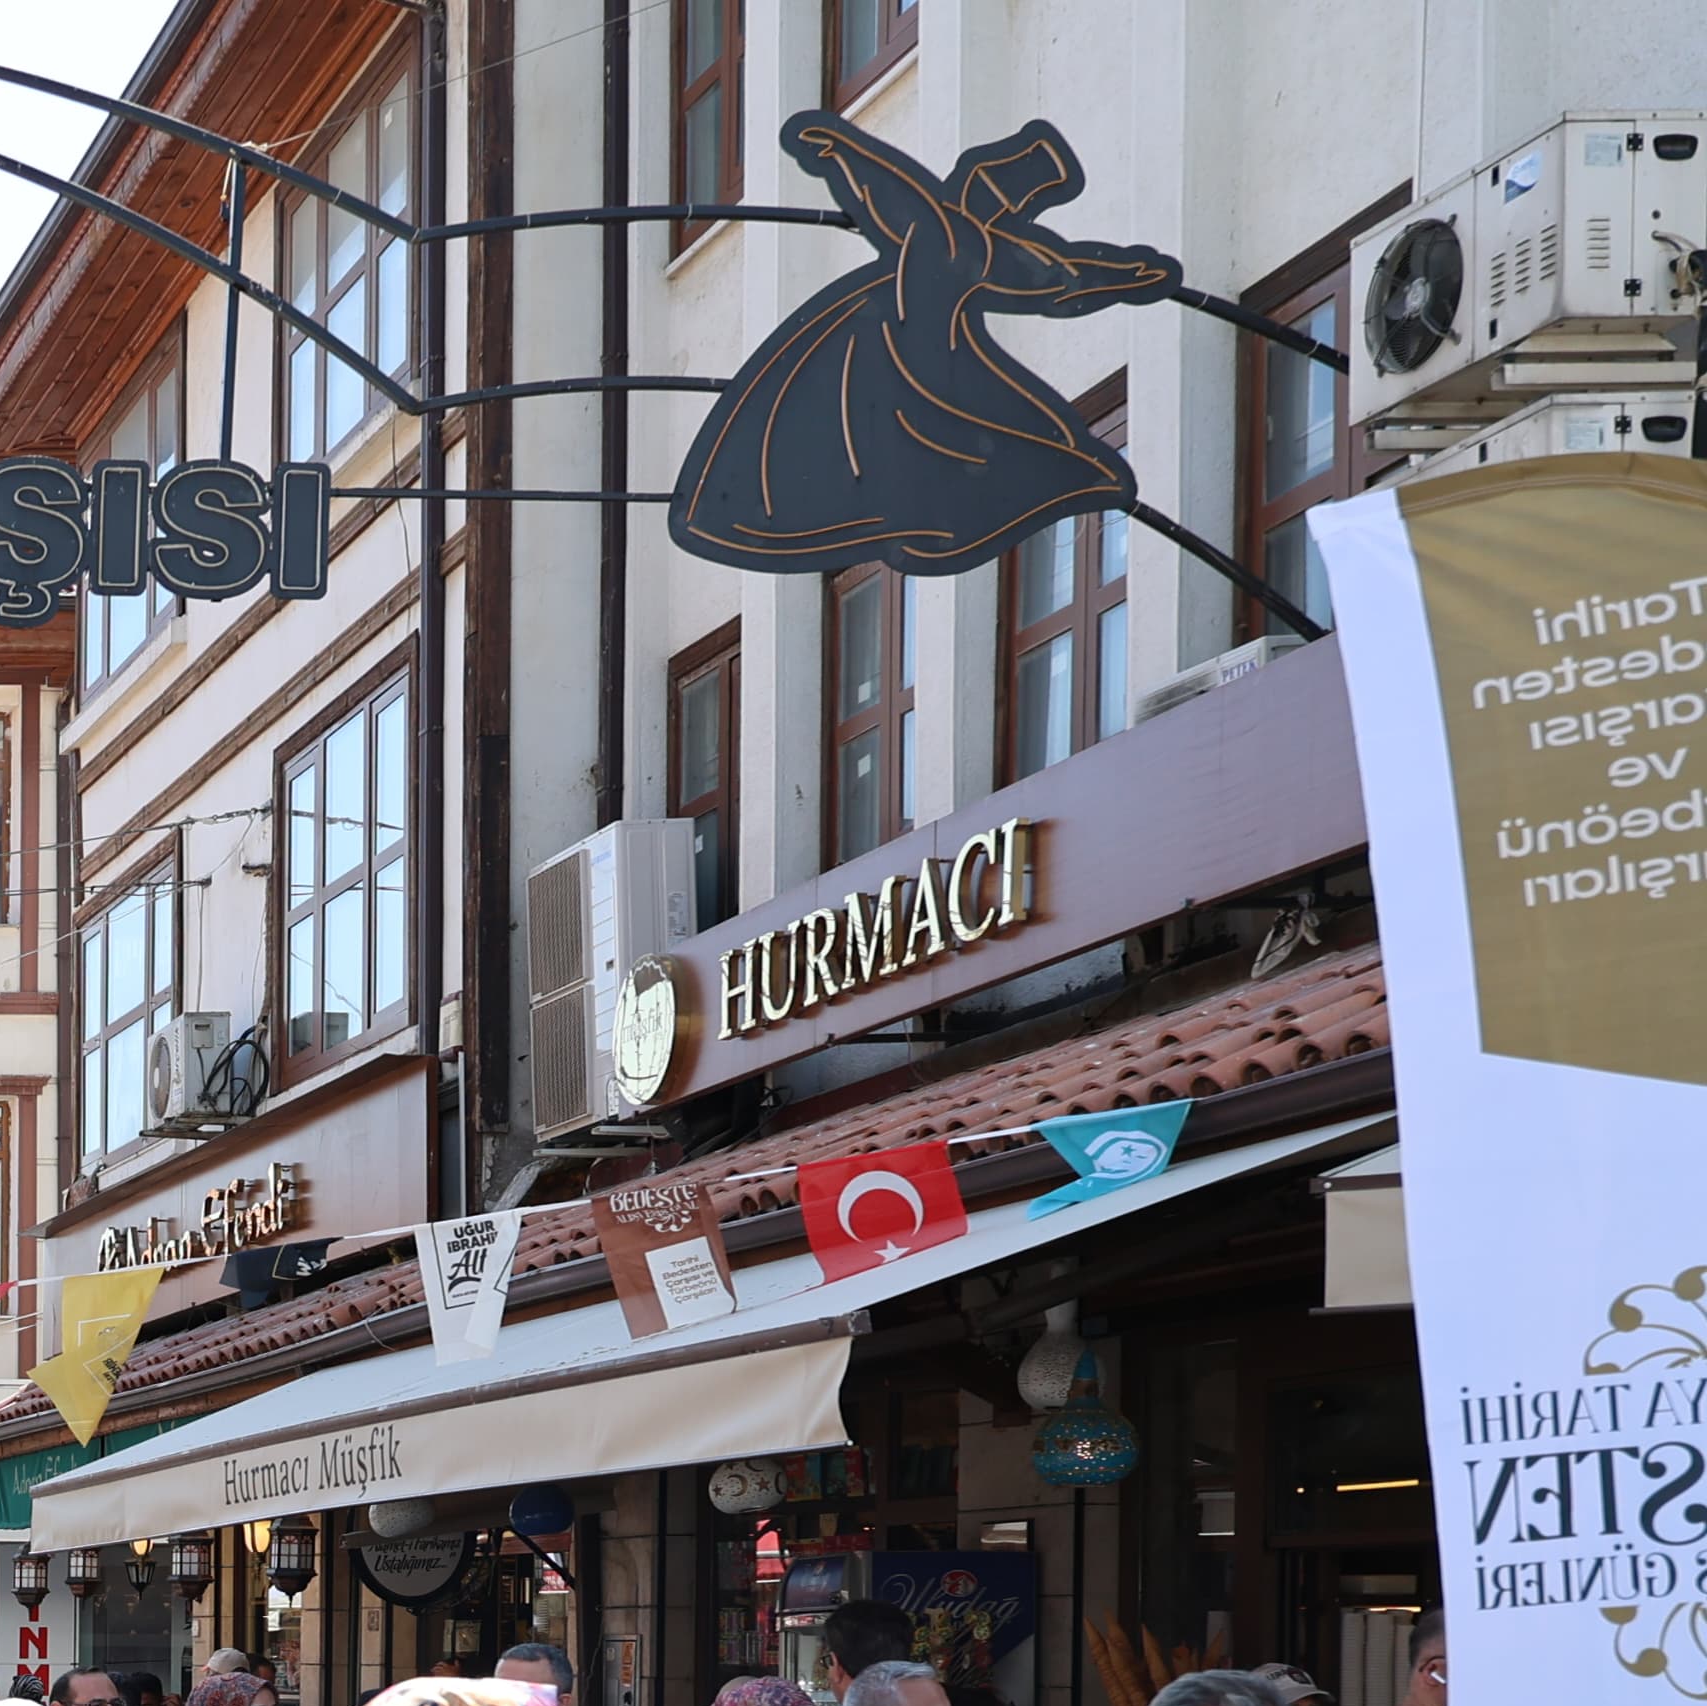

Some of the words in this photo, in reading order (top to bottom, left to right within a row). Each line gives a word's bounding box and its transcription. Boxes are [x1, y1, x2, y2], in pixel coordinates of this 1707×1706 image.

[717, 817, 1032, 1041] HURMACI
[447, 1231, 498, 1253] İBRAHİ
[454, 1220, 495, 1238] UĞUR
[447, 1248, 487, 1280] Alt
[224, 1456, 309, 1505] Hurmacı
[319, 1424, 403, 1498] Müşfik
